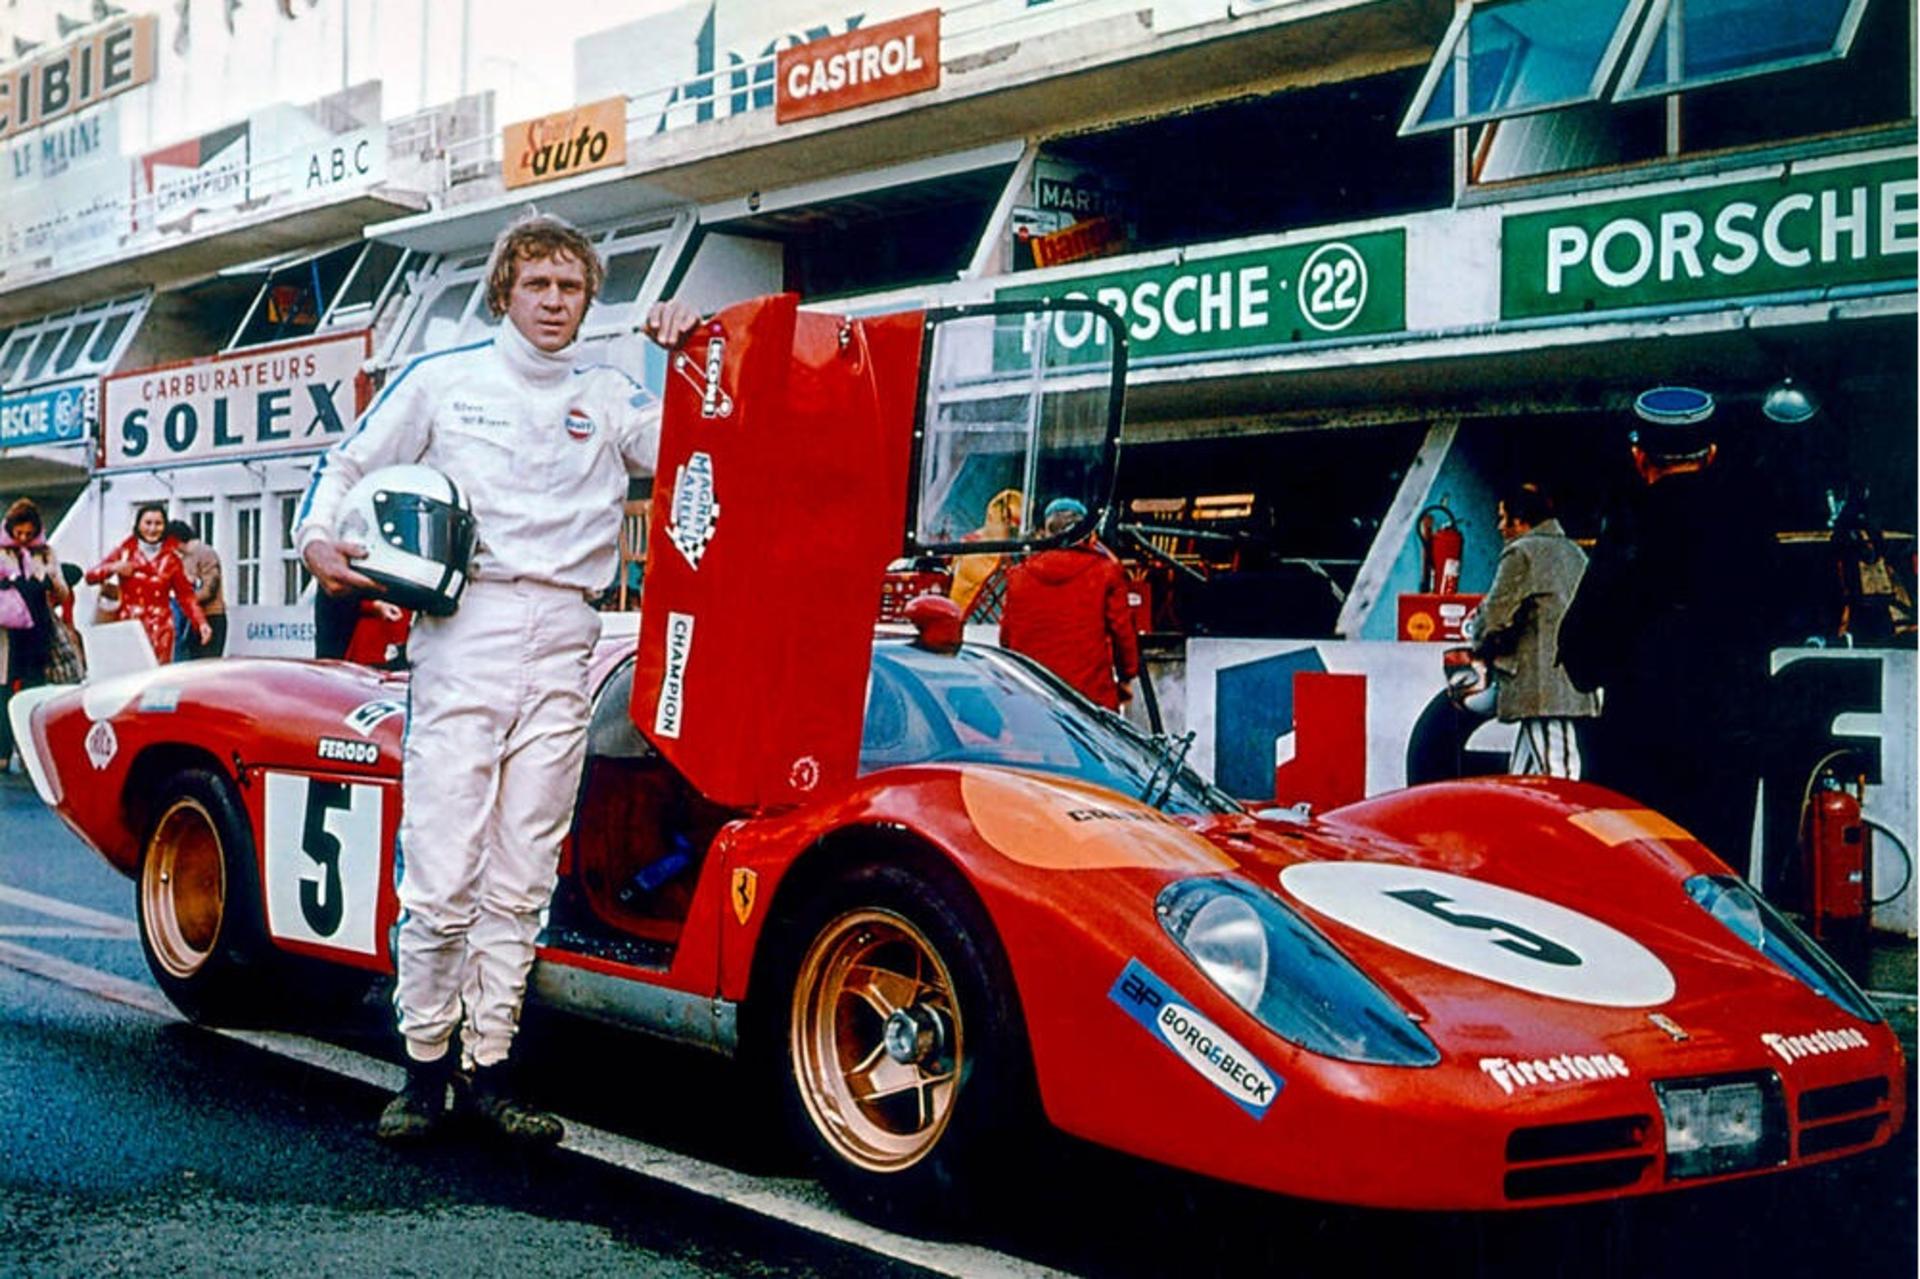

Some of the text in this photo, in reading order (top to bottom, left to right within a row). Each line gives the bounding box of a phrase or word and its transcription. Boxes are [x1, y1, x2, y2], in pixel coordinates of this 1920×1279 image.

[787, 36, 922, 99] CASTROL
[306, 140, 370, 188] A.B.C
[532, 125, 608, 176] auto
[1546, 178, 1918, 294] PORSCHE
[1022, 257, 1358, 353] PORSCHE 22
[142, 353, 316, 401] CARBURATEURS
[122, 379, 345, 457] SOLEX
[247, 622, 314, 642] GARNITURES
[663, 620, 688, 732] CHAMPION
[318, 739, 377, 764] FERODO
[299, 779, 352, 938] 5
[1383, 888, 1582, 966] 5
[1479, 1052, 1630, 1094] Firestone
[1762, 1026, 1869, 1066] Firestone
